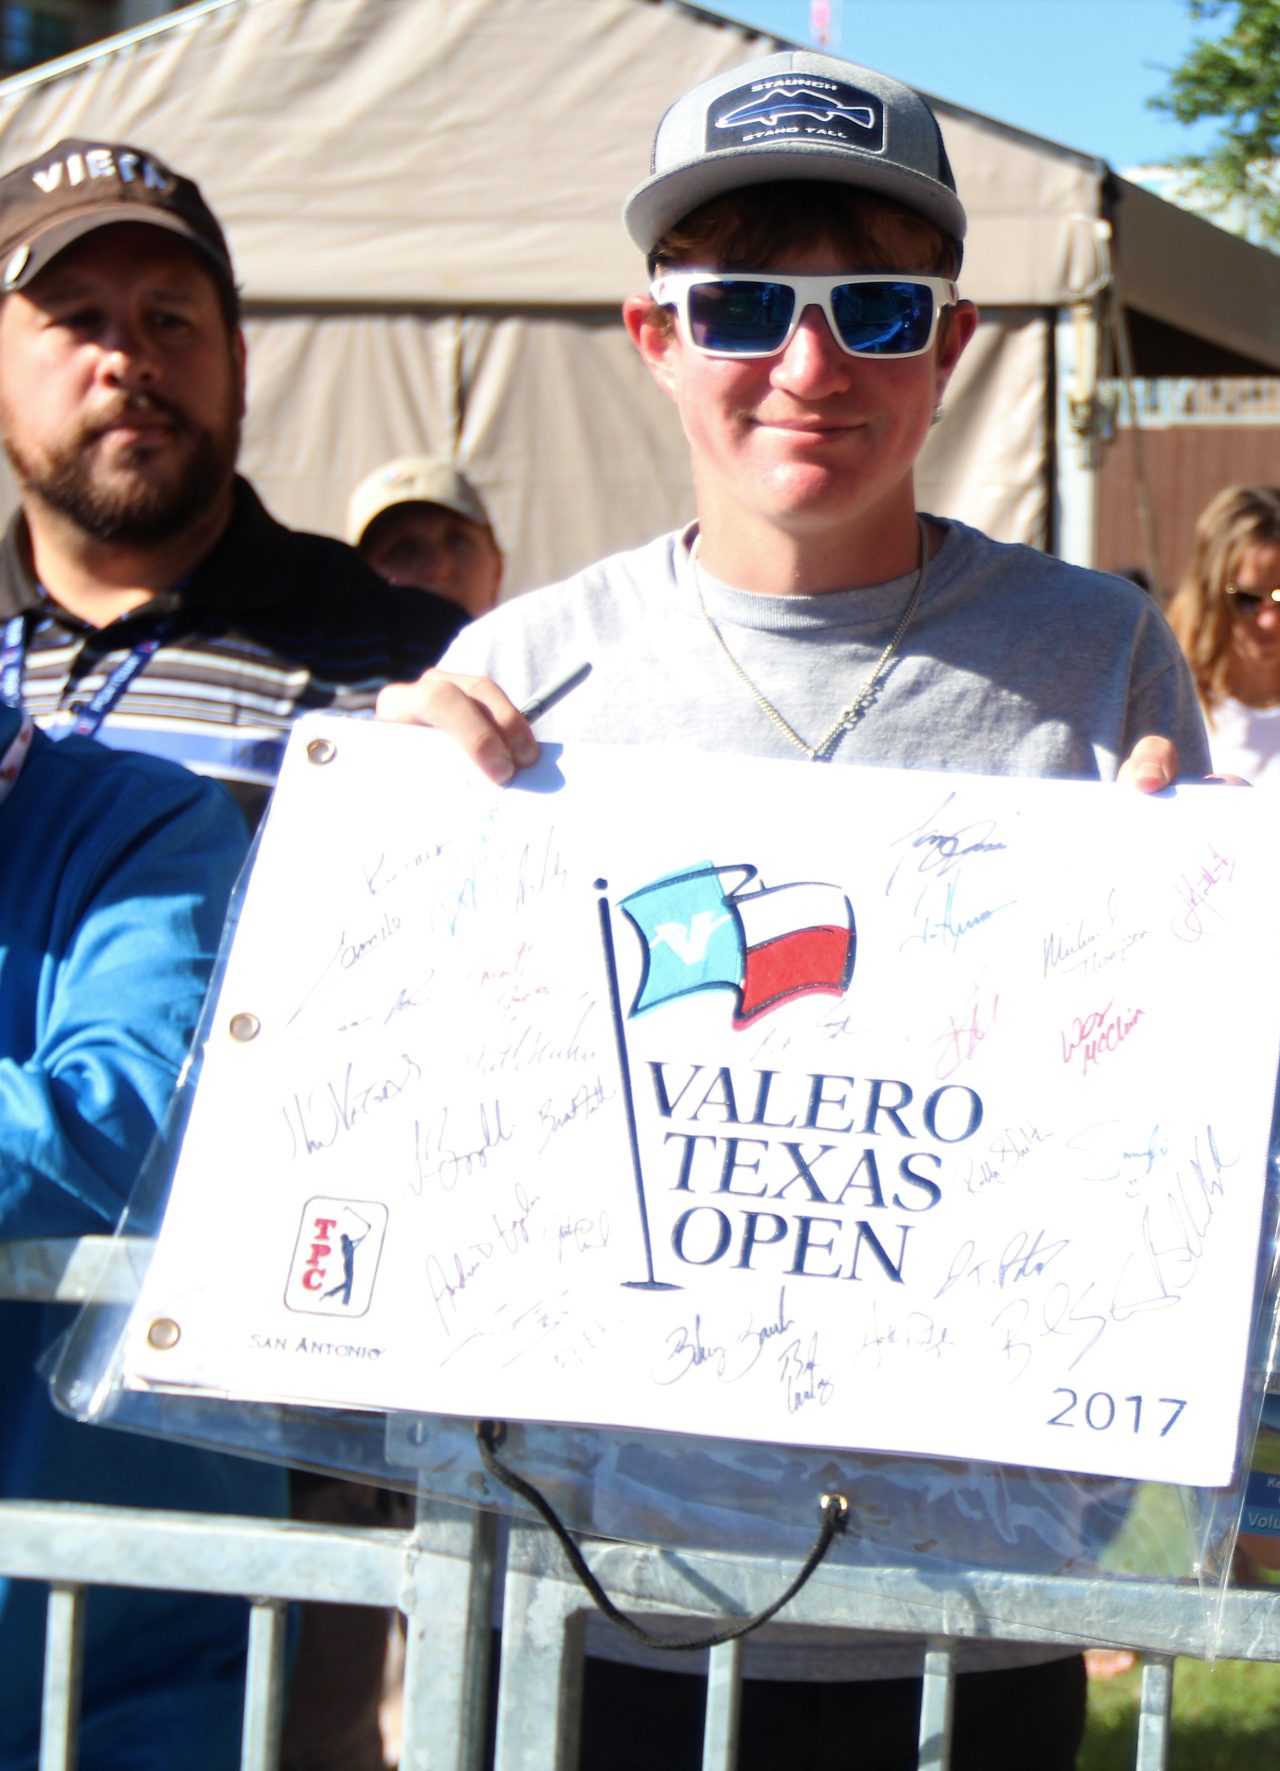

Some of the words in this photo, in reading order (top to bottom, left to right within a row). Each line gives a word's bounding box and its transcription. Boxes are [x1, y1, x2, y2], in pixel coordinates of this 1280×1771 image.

[751, 79, 839, 93] STAUNCH
[742, 127, 801, 142] STAND
[804, 127, 848, 140] TALL
[645, 1060, 984, 1144] VALERO
[662, 1131, 942, 1212] TEXAS
[301, 1217, 337, 1291] TPC
[670, 1205, 915, 1286] OPEN
[251, 1333, 287, 1350] SAN
[296, 1337, 382, 1360] ANTONIO
[1047, 1387, 1188, 1437] 2017
